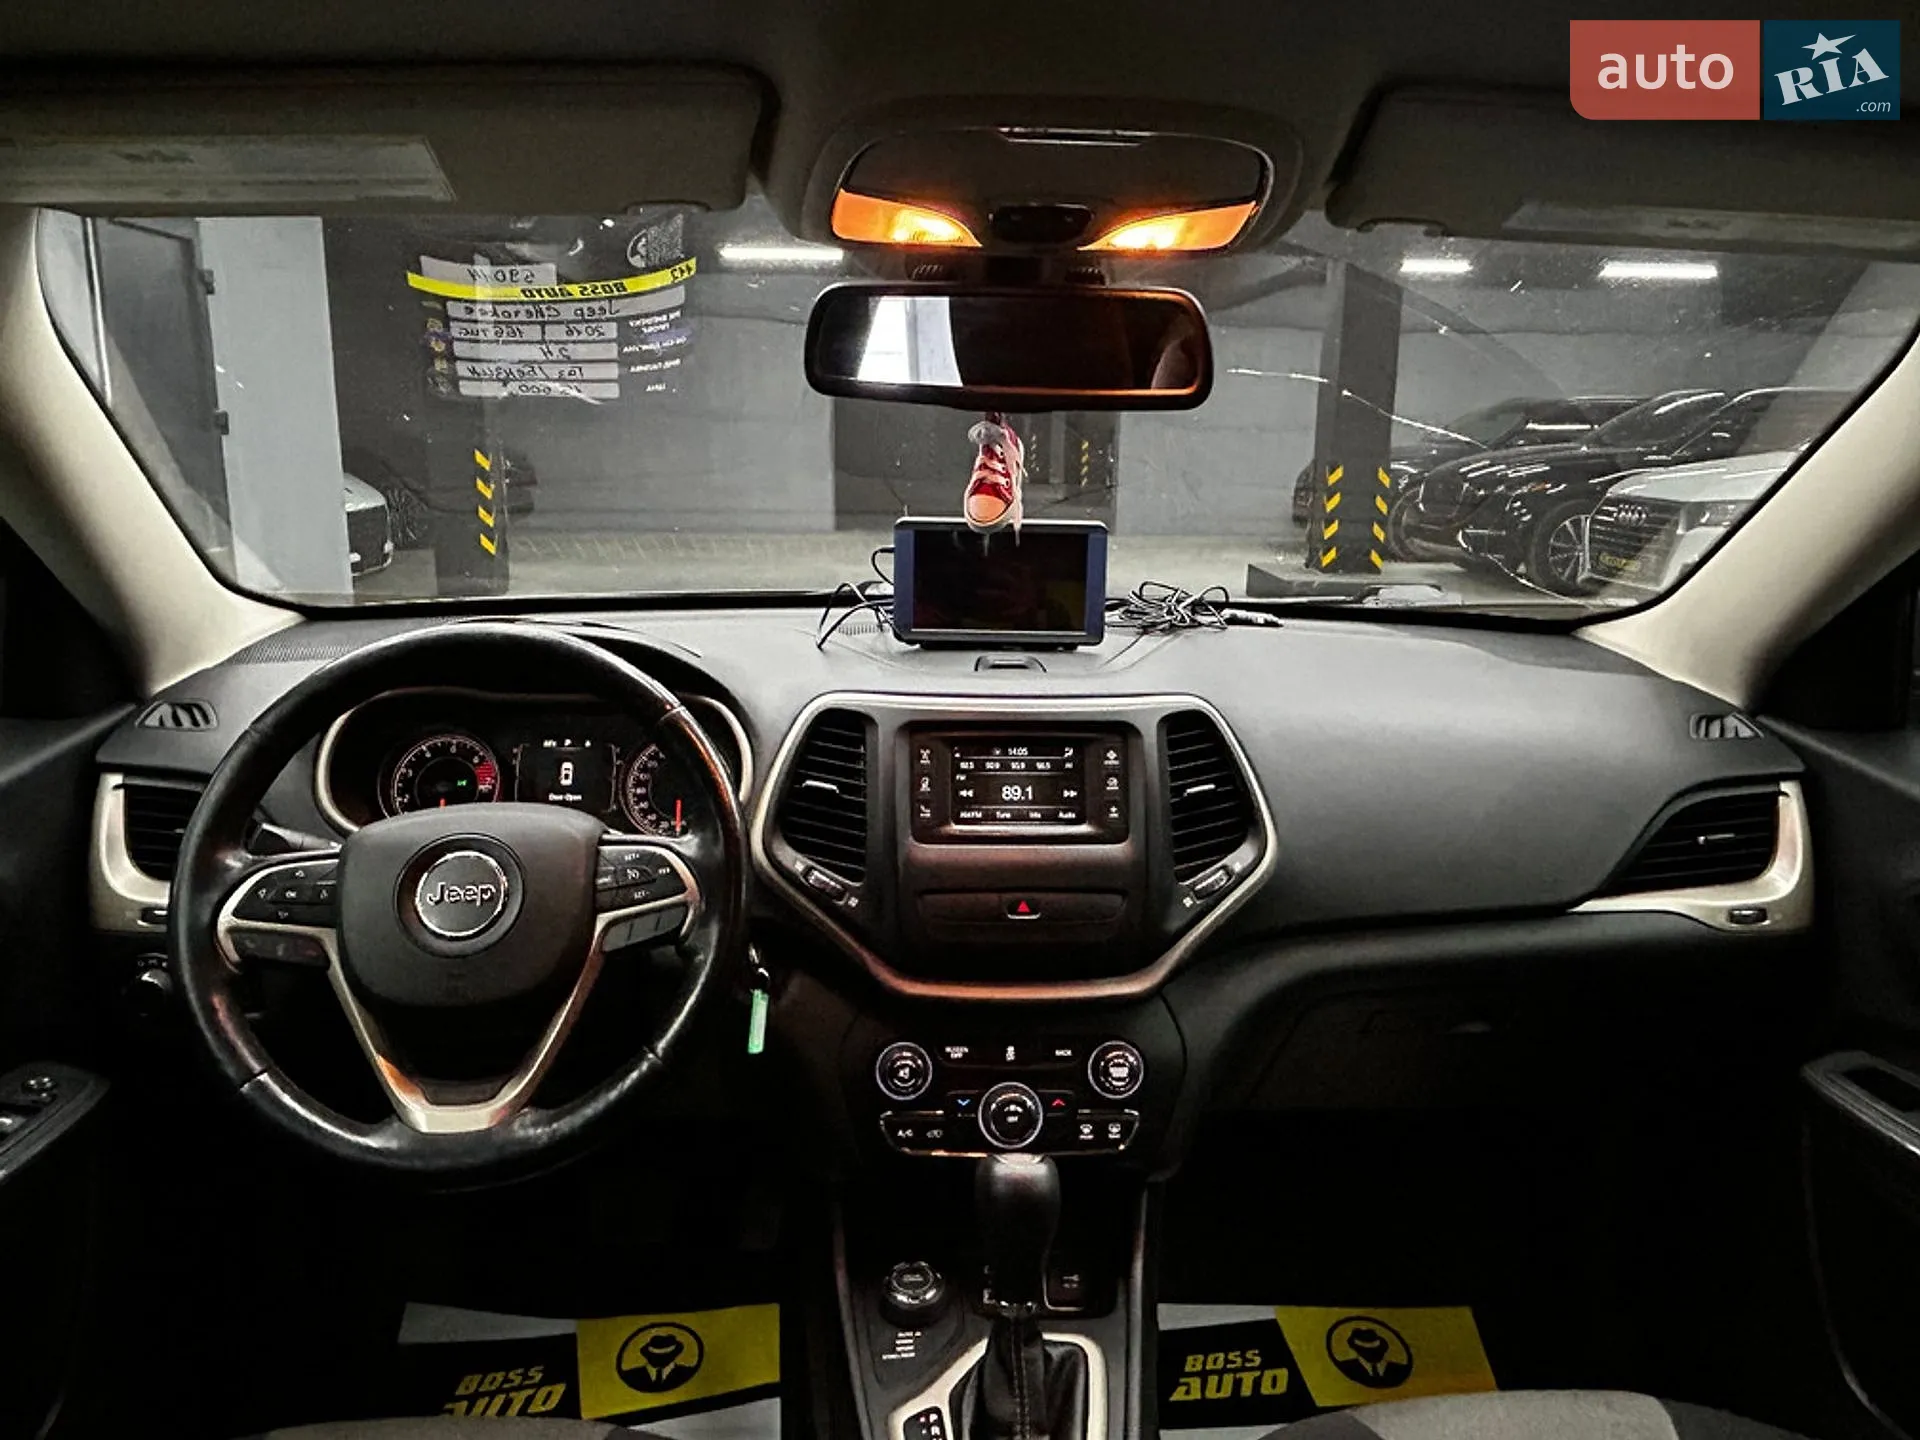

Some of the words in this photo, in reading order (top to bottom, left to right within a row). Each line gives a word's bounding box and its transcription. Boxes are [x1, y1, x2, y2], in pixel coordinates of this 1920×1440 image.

[1001, 785, 1033, 801] 89.1
[426, 881, 497, 907] Jeep
[1184, 1349, 1262, 1373] BOSS
[454, 1365, 545, 1396] BOSS
[1168, 1368, 1289, 1402] AUTO
